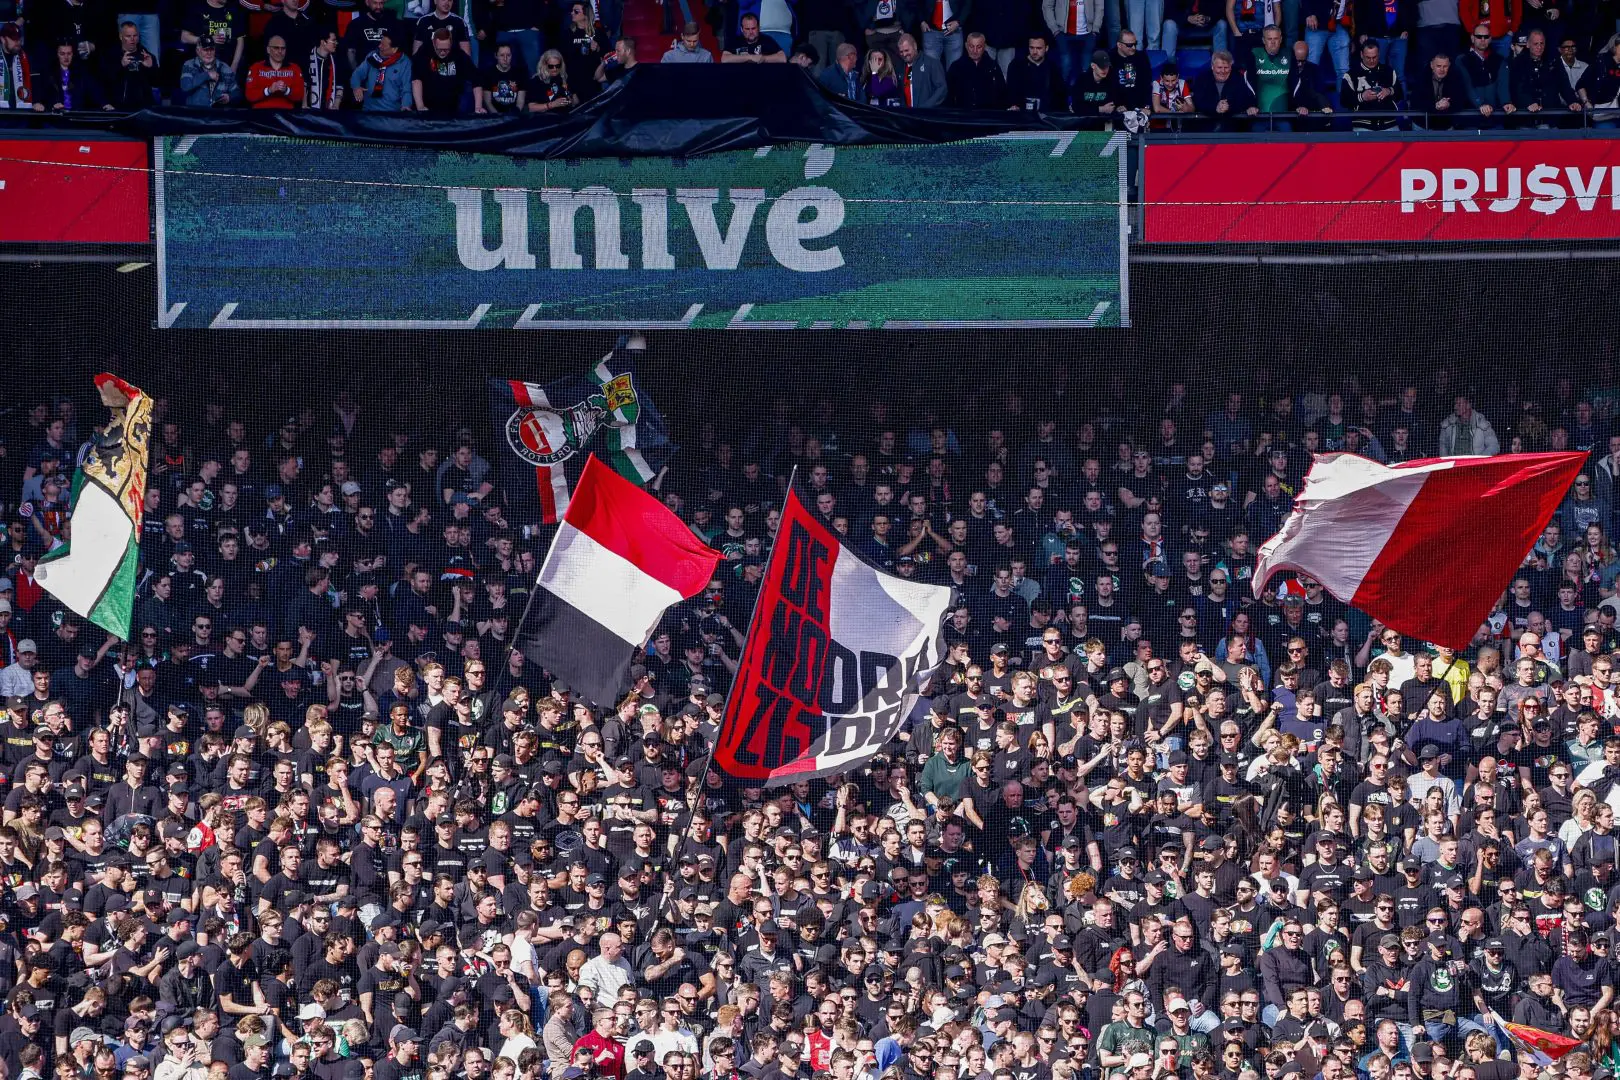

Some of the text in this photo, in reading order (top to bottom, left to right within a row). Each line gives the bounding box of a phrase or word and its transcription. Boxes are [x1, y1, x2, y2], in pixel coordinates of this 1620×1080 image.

[209, 20, 228, 28] Euro
[447, 143, 846, 272] univé
[781, 517, 829, 623] DE
